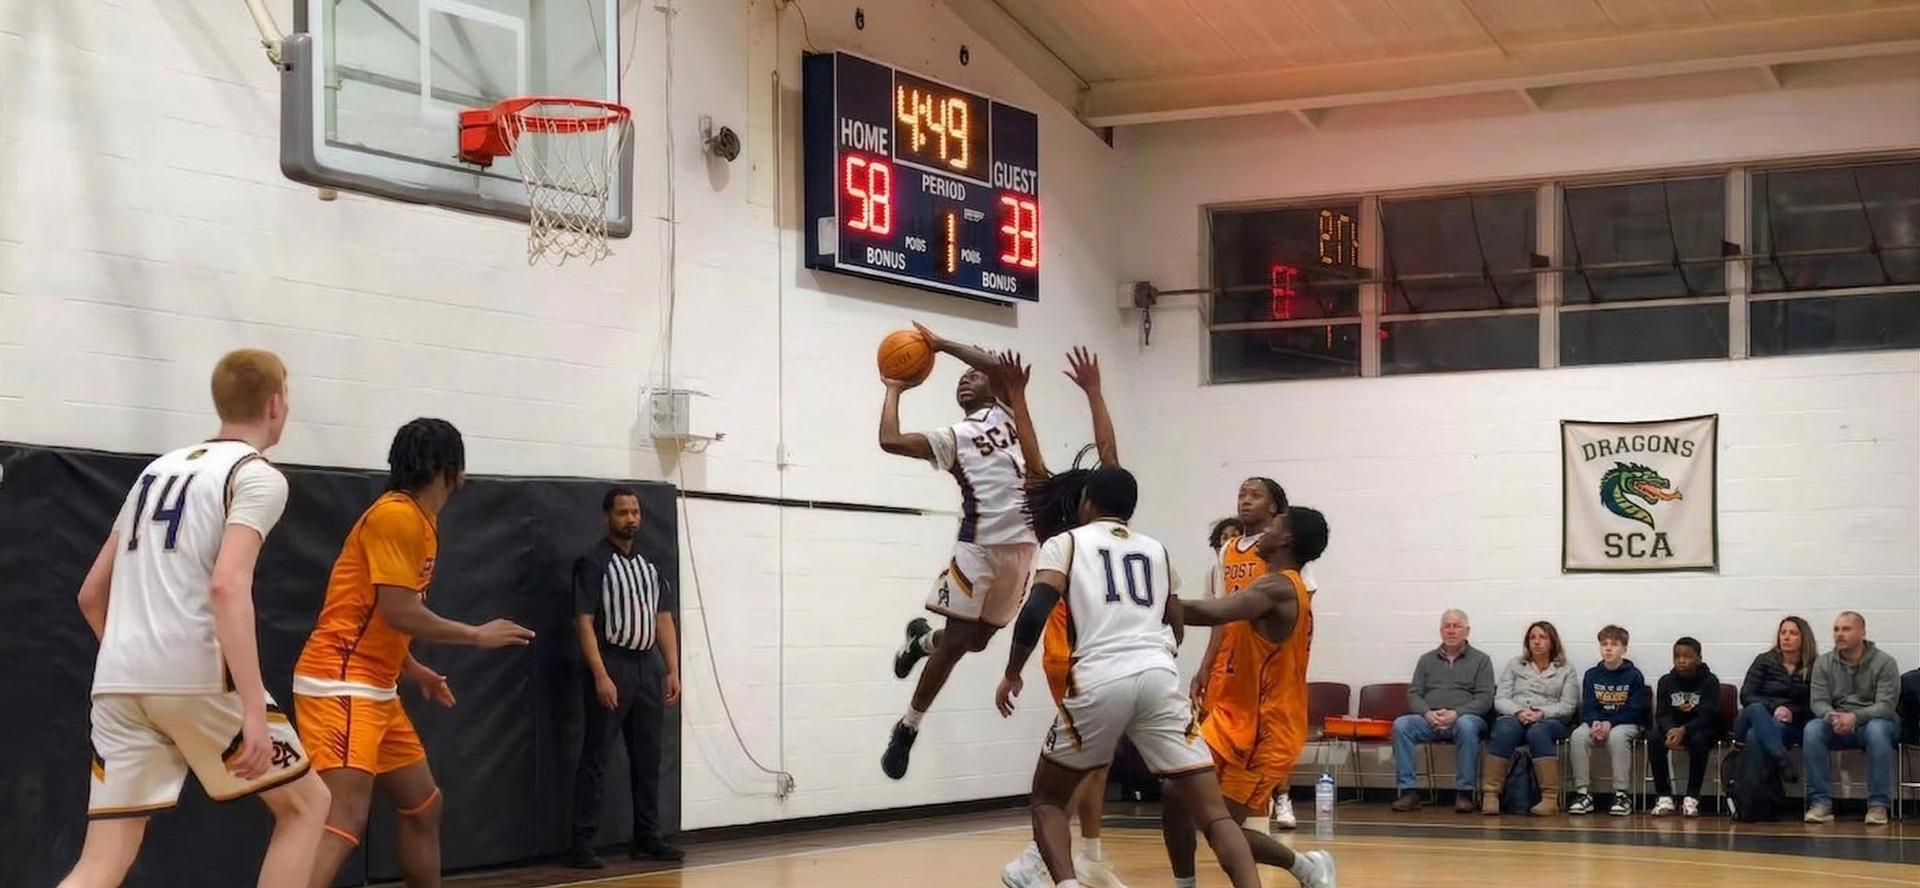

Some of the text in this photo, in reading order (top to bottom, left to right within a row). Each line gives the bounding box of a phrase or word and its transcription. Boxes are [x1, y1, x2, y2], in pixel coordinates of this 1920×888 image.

[841, 118, 888, 154] HOME
[897, 85, 969, 169] 4:49
[846, 156, 890, 235] 58
[922, 174, 966, 201] PERIOD
[994, 161, 1037, 195] GUEST
[947, 213, 955, 273] 1
[1001, 196, 1038, 267] 33
[866, 246, 906, 270] BONUS
[982, 271, 1017, 293] BONUS
[1582, 435, 1695, 461] DRAGONS
[127, 473, 196, 553] 14
[1604, 532, 1674, 558] SCA
[1099, 549, 1153, 607] 10
[1224, 562, 1257, 581] POST
